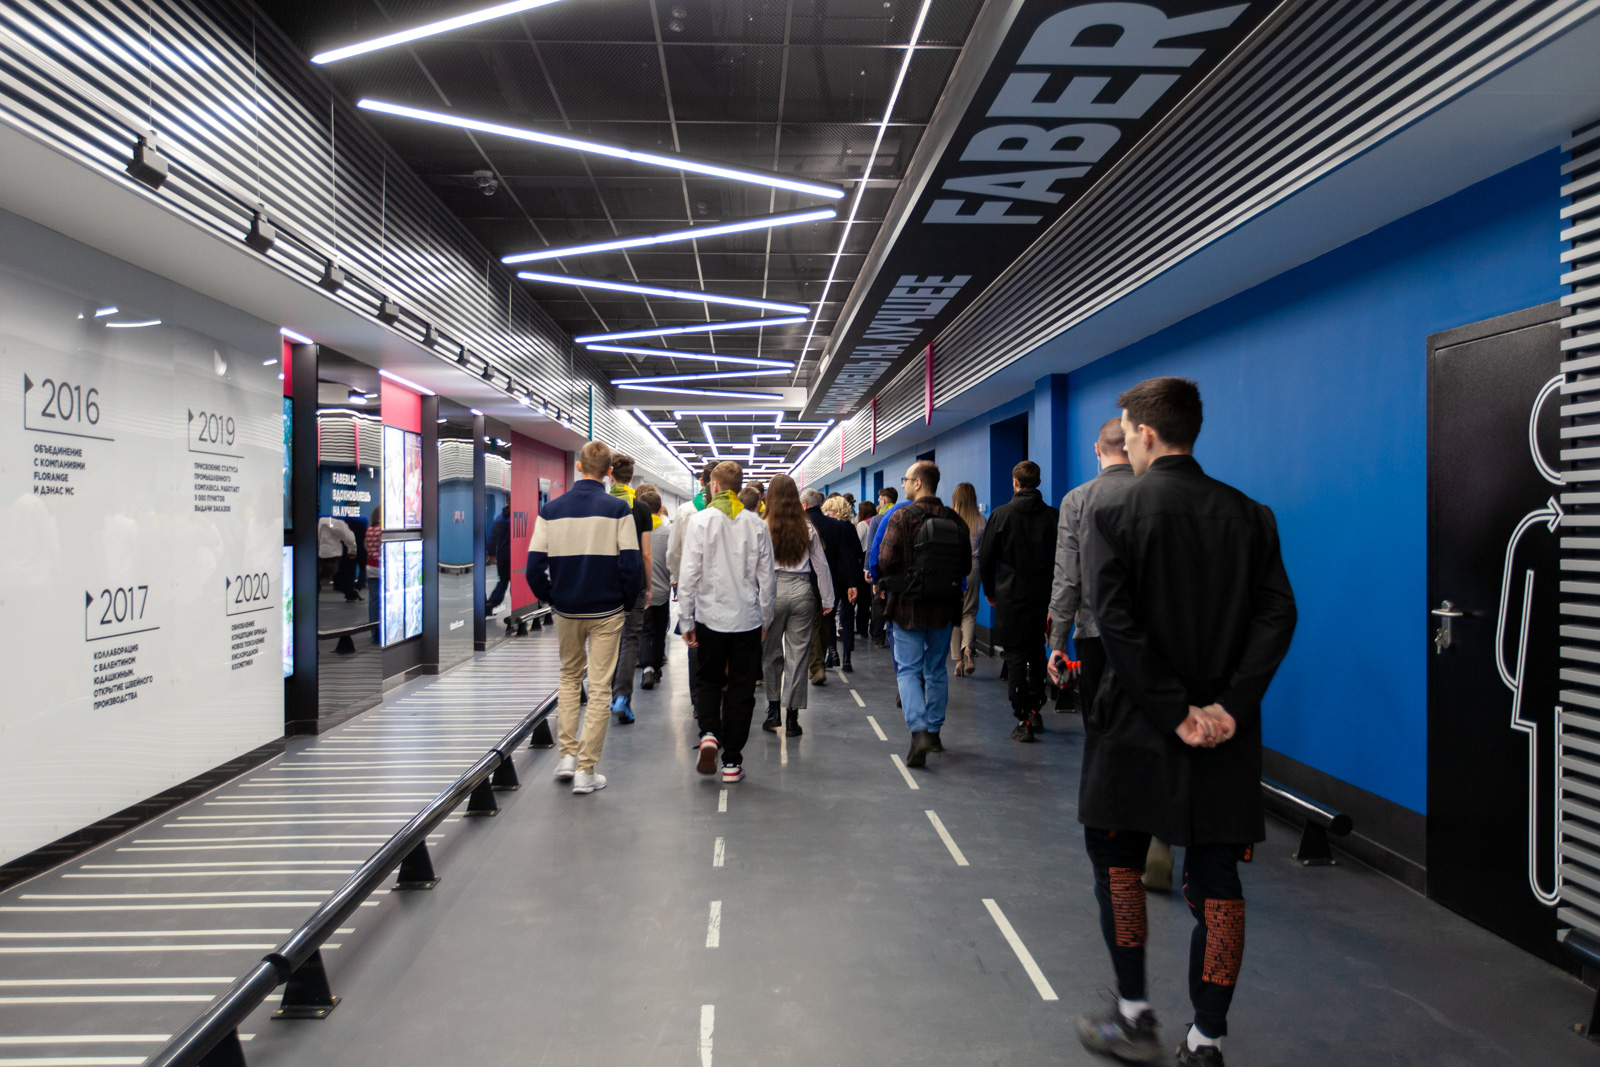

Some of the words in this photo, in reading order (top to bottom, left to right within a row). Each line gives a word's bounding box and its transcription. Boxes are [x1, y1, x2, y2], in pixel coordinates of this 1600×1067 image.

[922, 2, 1251, 225] FABER
[862, 274, 973, 342] ЛУЧШЕЕ
[849, 343, 911, 359] НА
[41, 378, 100, 425] 2016
[199, 411, 236, 446] 2019
[34, 444, 83, 457] ОБЪЕДИНЕНИЕ
[34, 458, 39, 467] С
[40, 458, 86, 470] КОМПАНИЯМИ
[194, 462, 221, 472] ПРИСВОЕНИЕ
[221, 465, 239, 474] СТАТУСА
[34, 471, 69, 482] FLORANGE
[194, 473, 231, 483] ПРОМЫШЛЕННОГО
[34, 485, 39, 494] И
[40, 485, 64, 496] ДЭНАС
[65, 486, 75, 495] МС
[220, 485, 240, 494] РАБОТАЕТ
[194, 504, 212, 513] ВЫДАЧИ
[213, 505, 231, 513] ЗАКАЗОВ
[332, 506, 340, 517] НА
[341, 506, 361, 517] ЛУЧШЕЕ
[235, 572, 270, 604] 2020
[100, 585, 148, 625] 2017
[94, 644, 138, 660] КОЛЛАБОРАЦИЯ
[94, 664, 98, 672] С
[99, 656, 136, 672] ВАЛЕНТИНОМ
[94, 683, 124, 698] ОТКРЫТИЕ
[124, 675, 153, 690] ШВЕЙНОГО
[94, 691, 138, 710] ПРОИЗВОДСТВА
